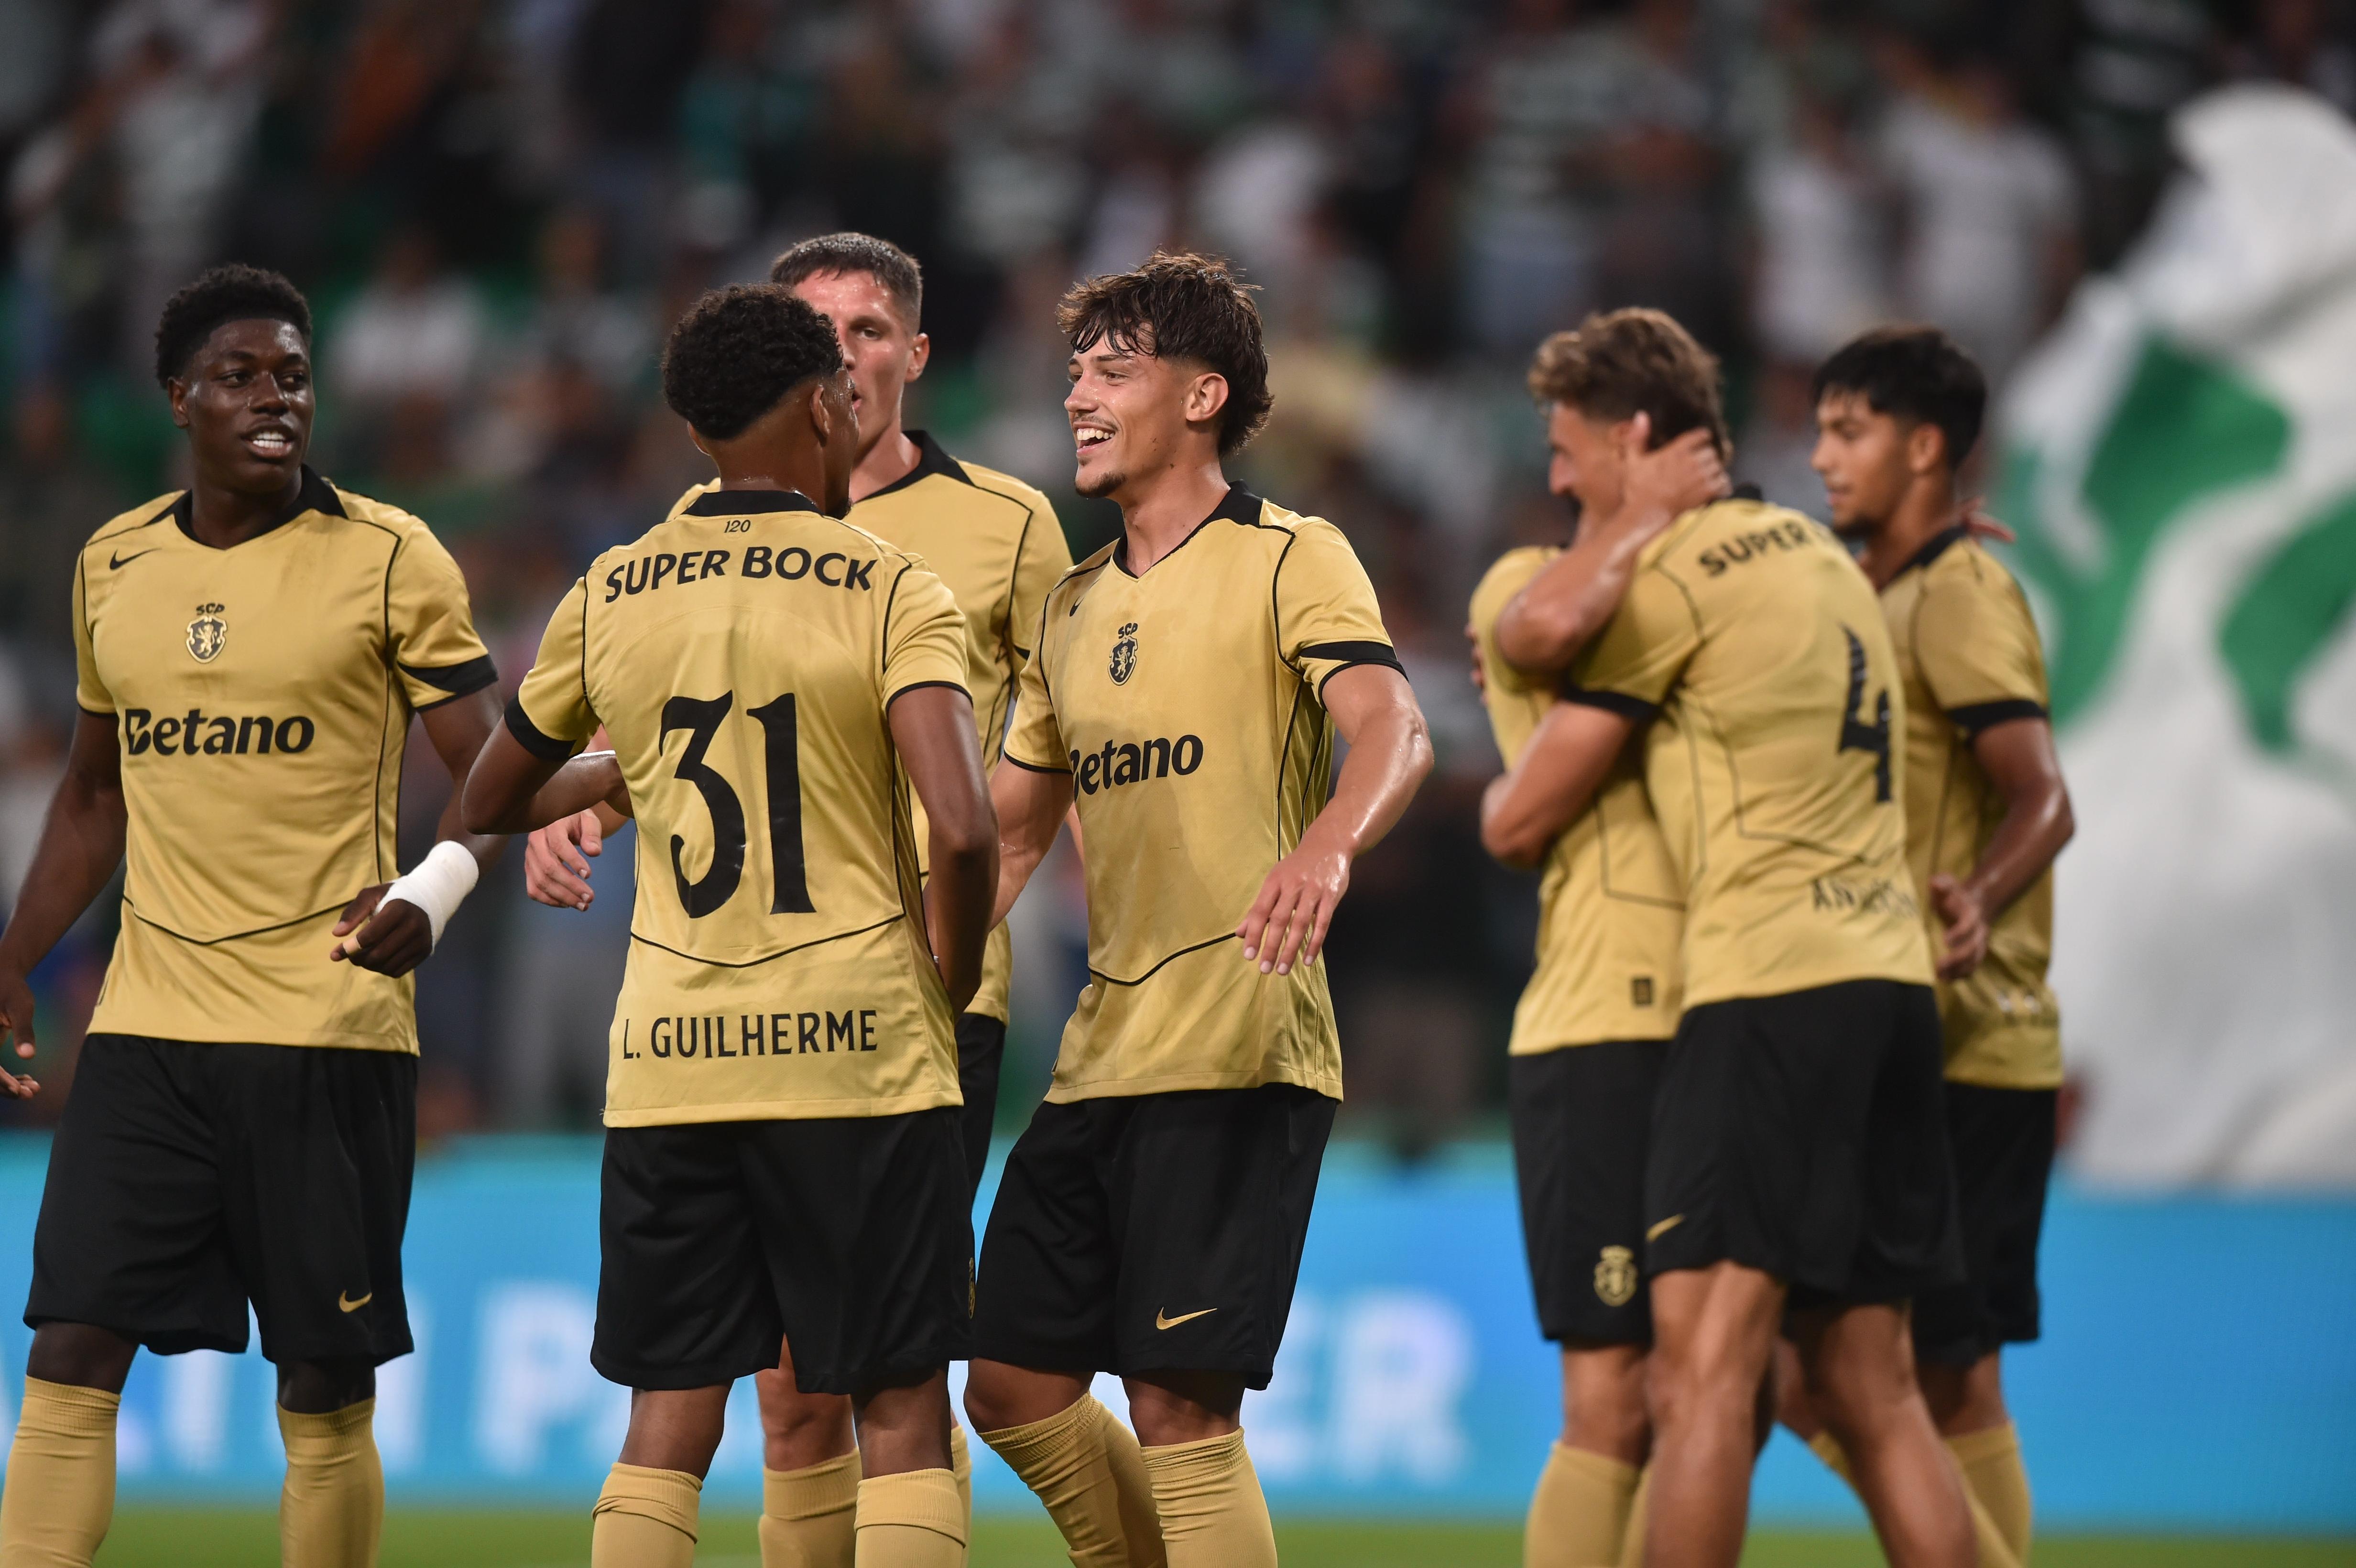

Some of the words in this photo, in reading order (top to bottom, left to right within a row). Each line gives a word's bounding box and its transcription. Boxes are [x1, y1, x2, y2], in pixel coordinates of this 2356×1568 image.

[723, 519, 751, 534] 120
[1699, 519, 1809, 578] SUPER
[605, 550, 730, 603] SUPER
[741, 546, 878, 591] BOCK
[196, 602, 225, 616] SCP
[1118, 622, 1138, 639] SCP
[125, 708, 315, 756] Betano
[1839, 622, 1892, 803] 4
[658, 689, 817, 919] 31
[623, 1018, 640, 1060] L.
[650, 1009, 878, 1058] GUILHERME
